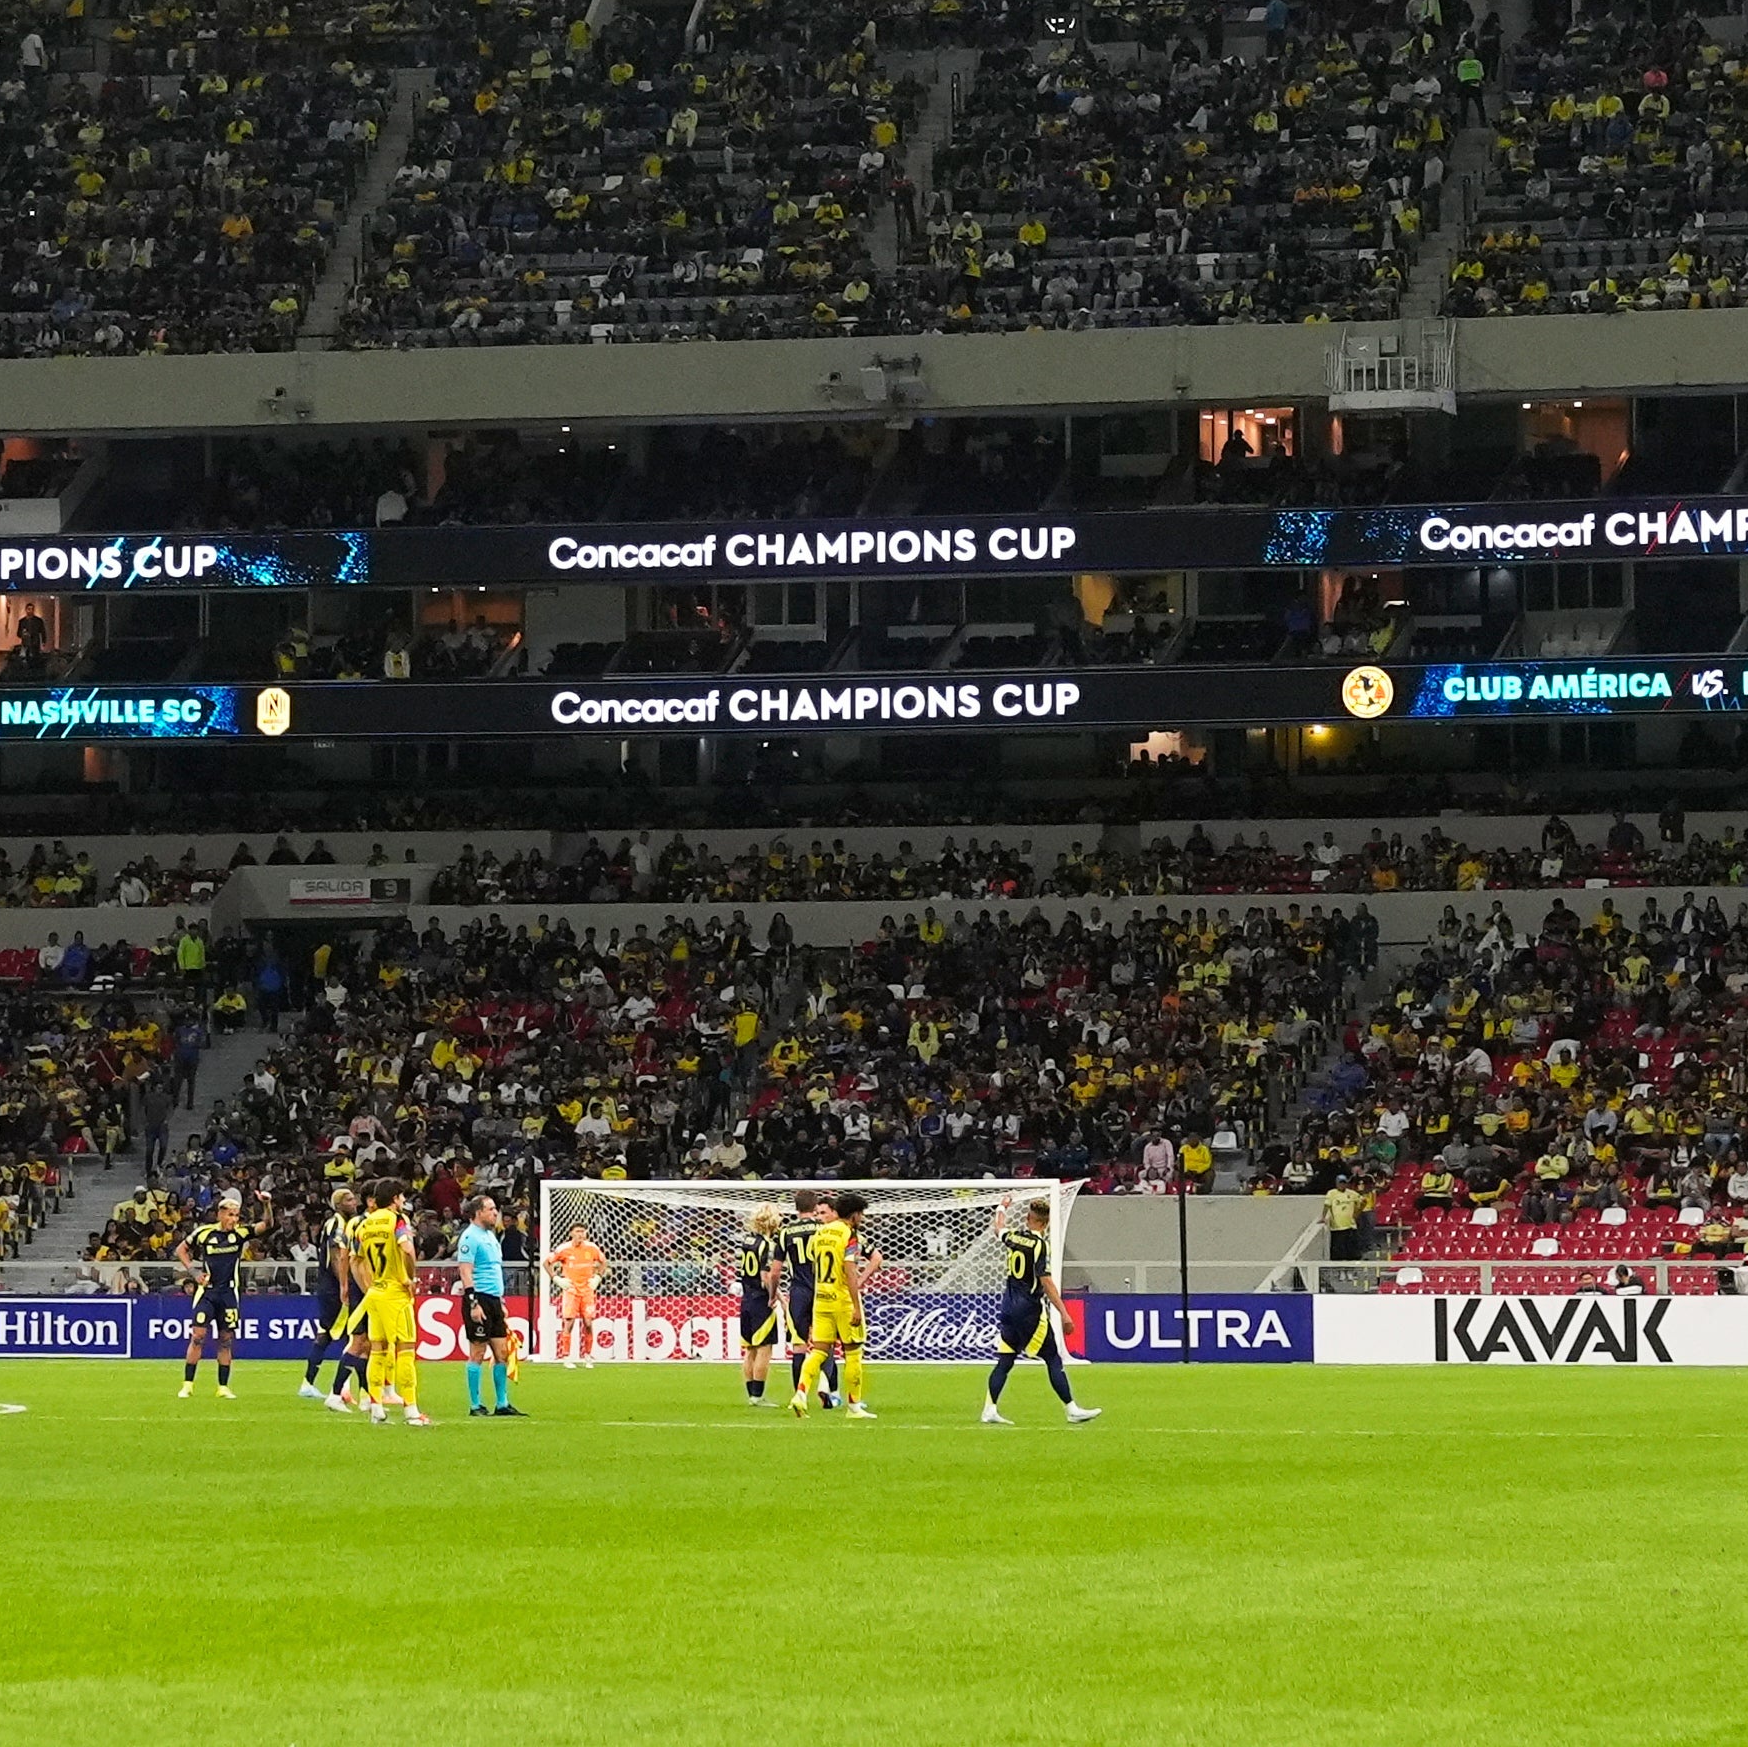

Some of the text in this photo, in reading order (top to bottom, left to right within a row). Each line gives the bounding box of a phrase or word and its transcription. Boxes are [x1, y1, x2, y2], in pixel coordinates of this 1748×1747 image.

[547, 526, 1077, 570] Concacaf CHAMPIONS CUP
[1419, 512, 1596, 551] Concacaf
[131, 544, 218, 580] CUP
[1443, 673, 1522, 702] CLUB
[1528, 666, 1672, 700] AMÉRICA
[0, 698, 156, 726] NASHVILLE
[160, 698, 203, 724] SC
[551, 682, 1081, 725] Concacaf CHAMPIONS CUP
[304, 879, 398, 897] SALIDA 9
[366, 1242, 388, 1278] 13
[816, 1250, 837, 1284] 12
[1105, 1309, 1292, 1350] ULTRA
[1434, 1297, 1674, 1363] KAVAK
